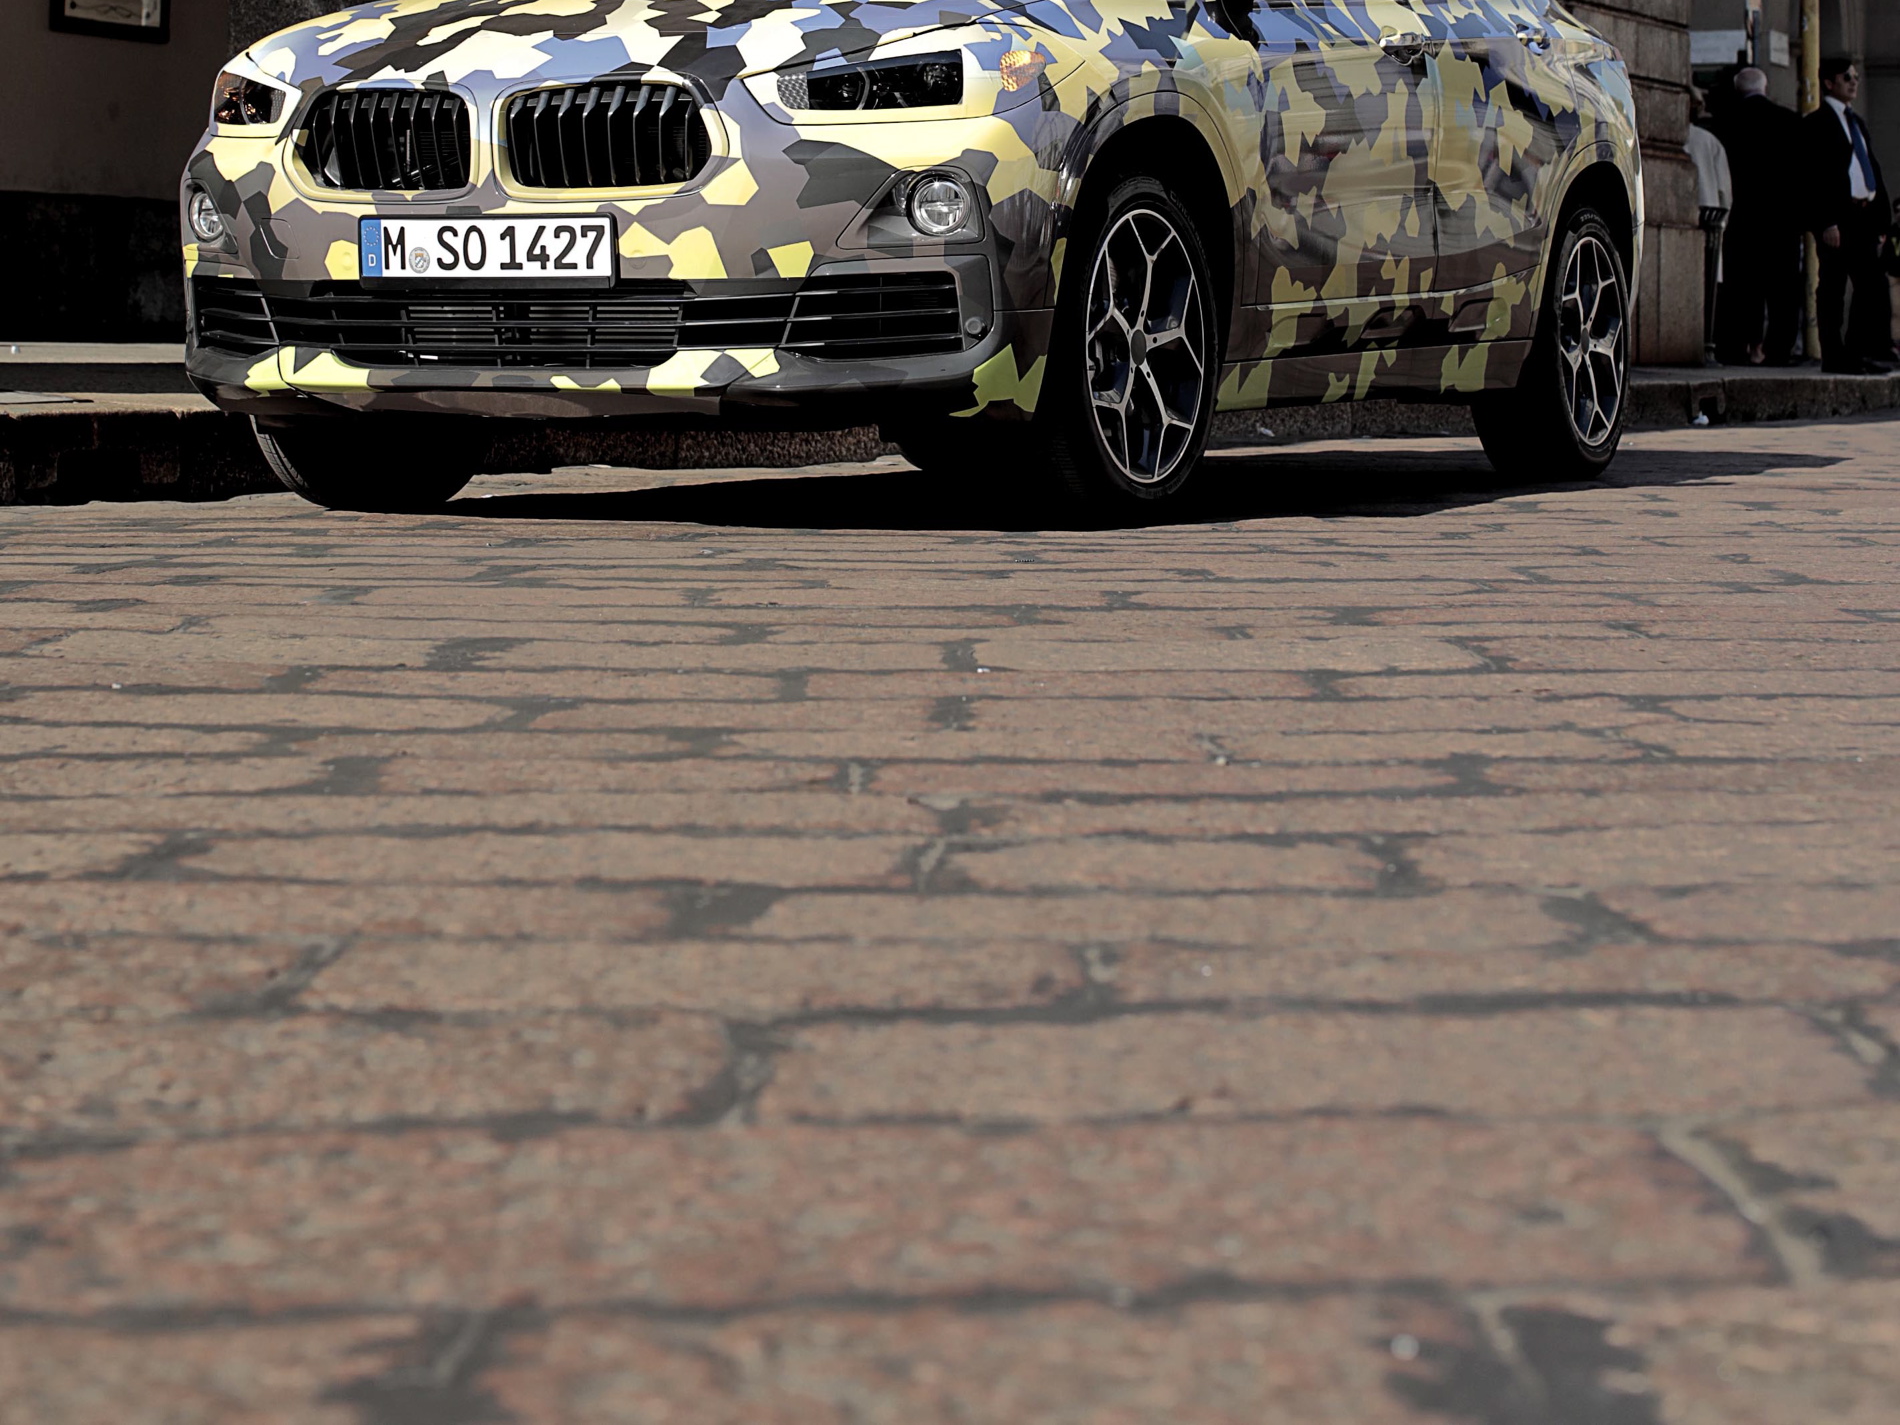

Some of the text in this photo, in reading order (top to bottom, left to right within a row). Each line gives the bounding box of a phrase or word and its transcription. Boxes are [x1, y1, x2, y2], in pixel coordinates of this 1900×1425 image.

[368, 253, 376, 267] D
[383, 225, 605, 271] M SO 1427
